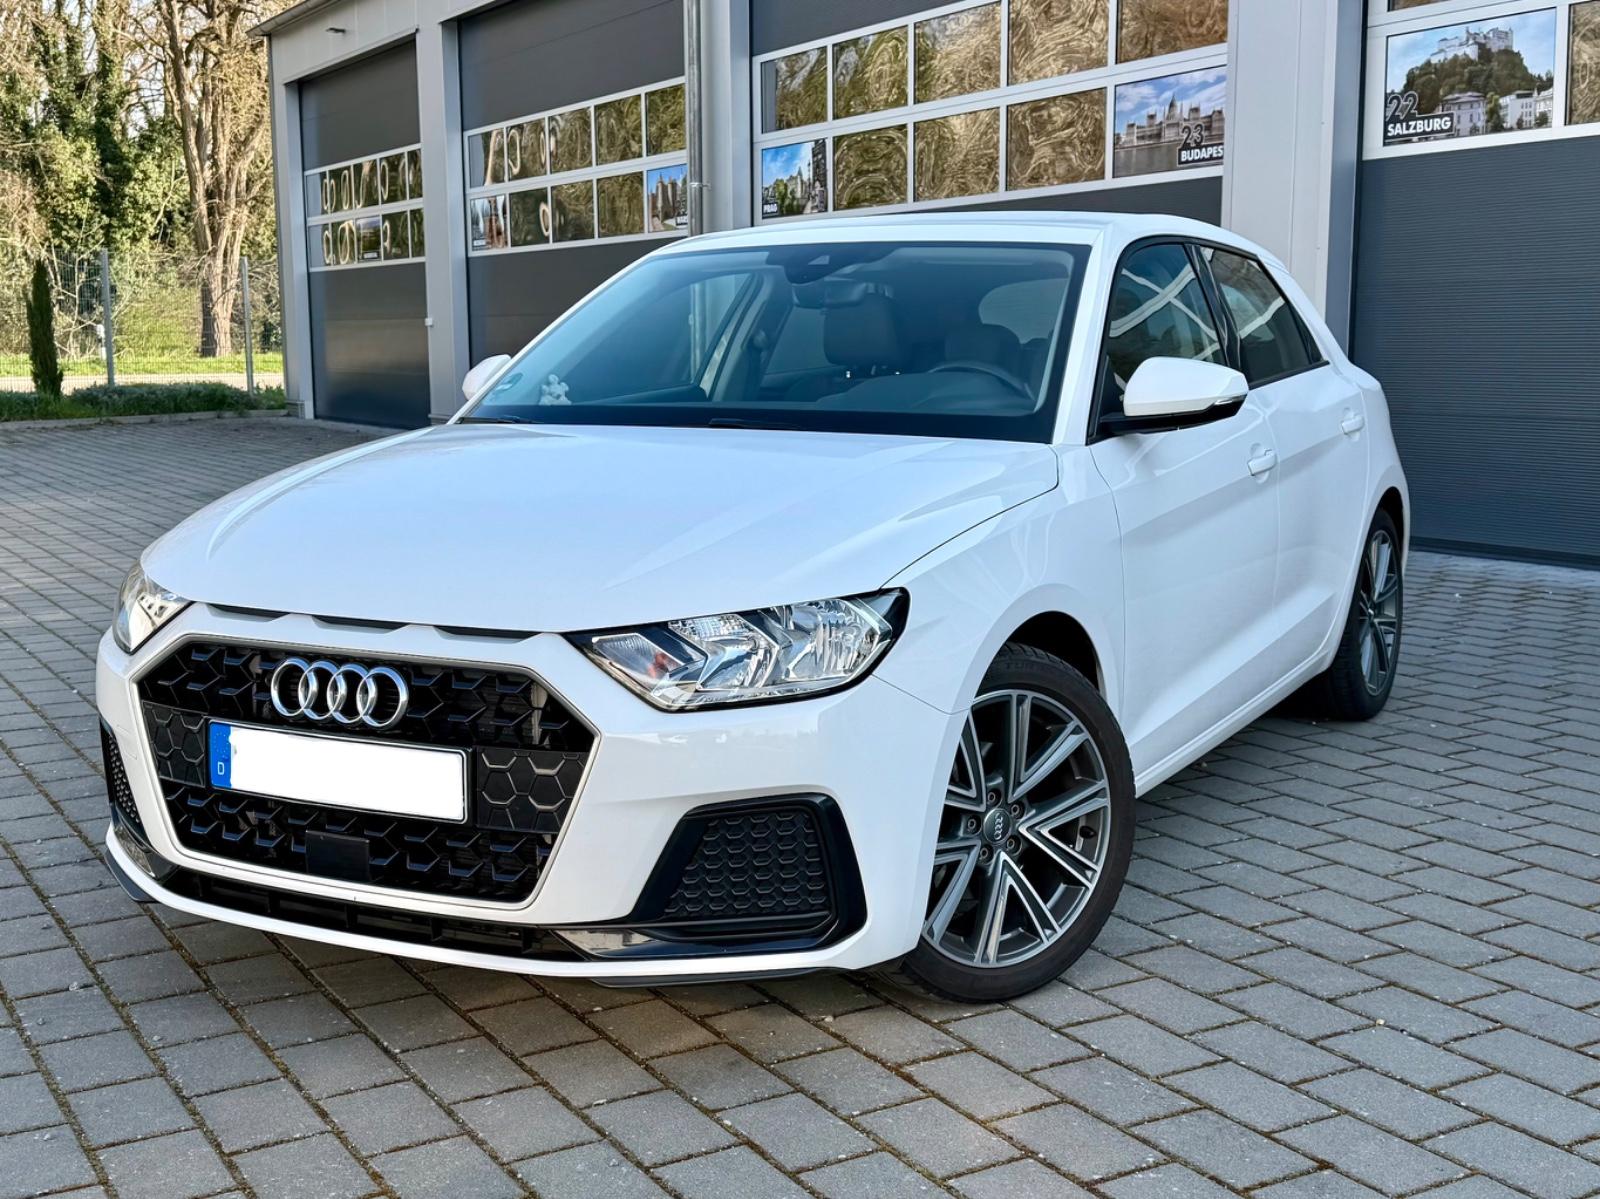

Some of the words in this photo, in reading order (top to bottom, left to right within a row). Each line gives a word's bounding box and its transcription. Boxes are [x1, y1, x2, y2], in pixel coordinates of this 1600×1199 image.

[1386, 91, 1418, 120] 22
[1181, 123, 1205, 148] 23
[1387, 117, 1452, 136] SALZBURG
[1181, 146, 1223, 161] BUDAPES
[217, 761, 225, 776] D
